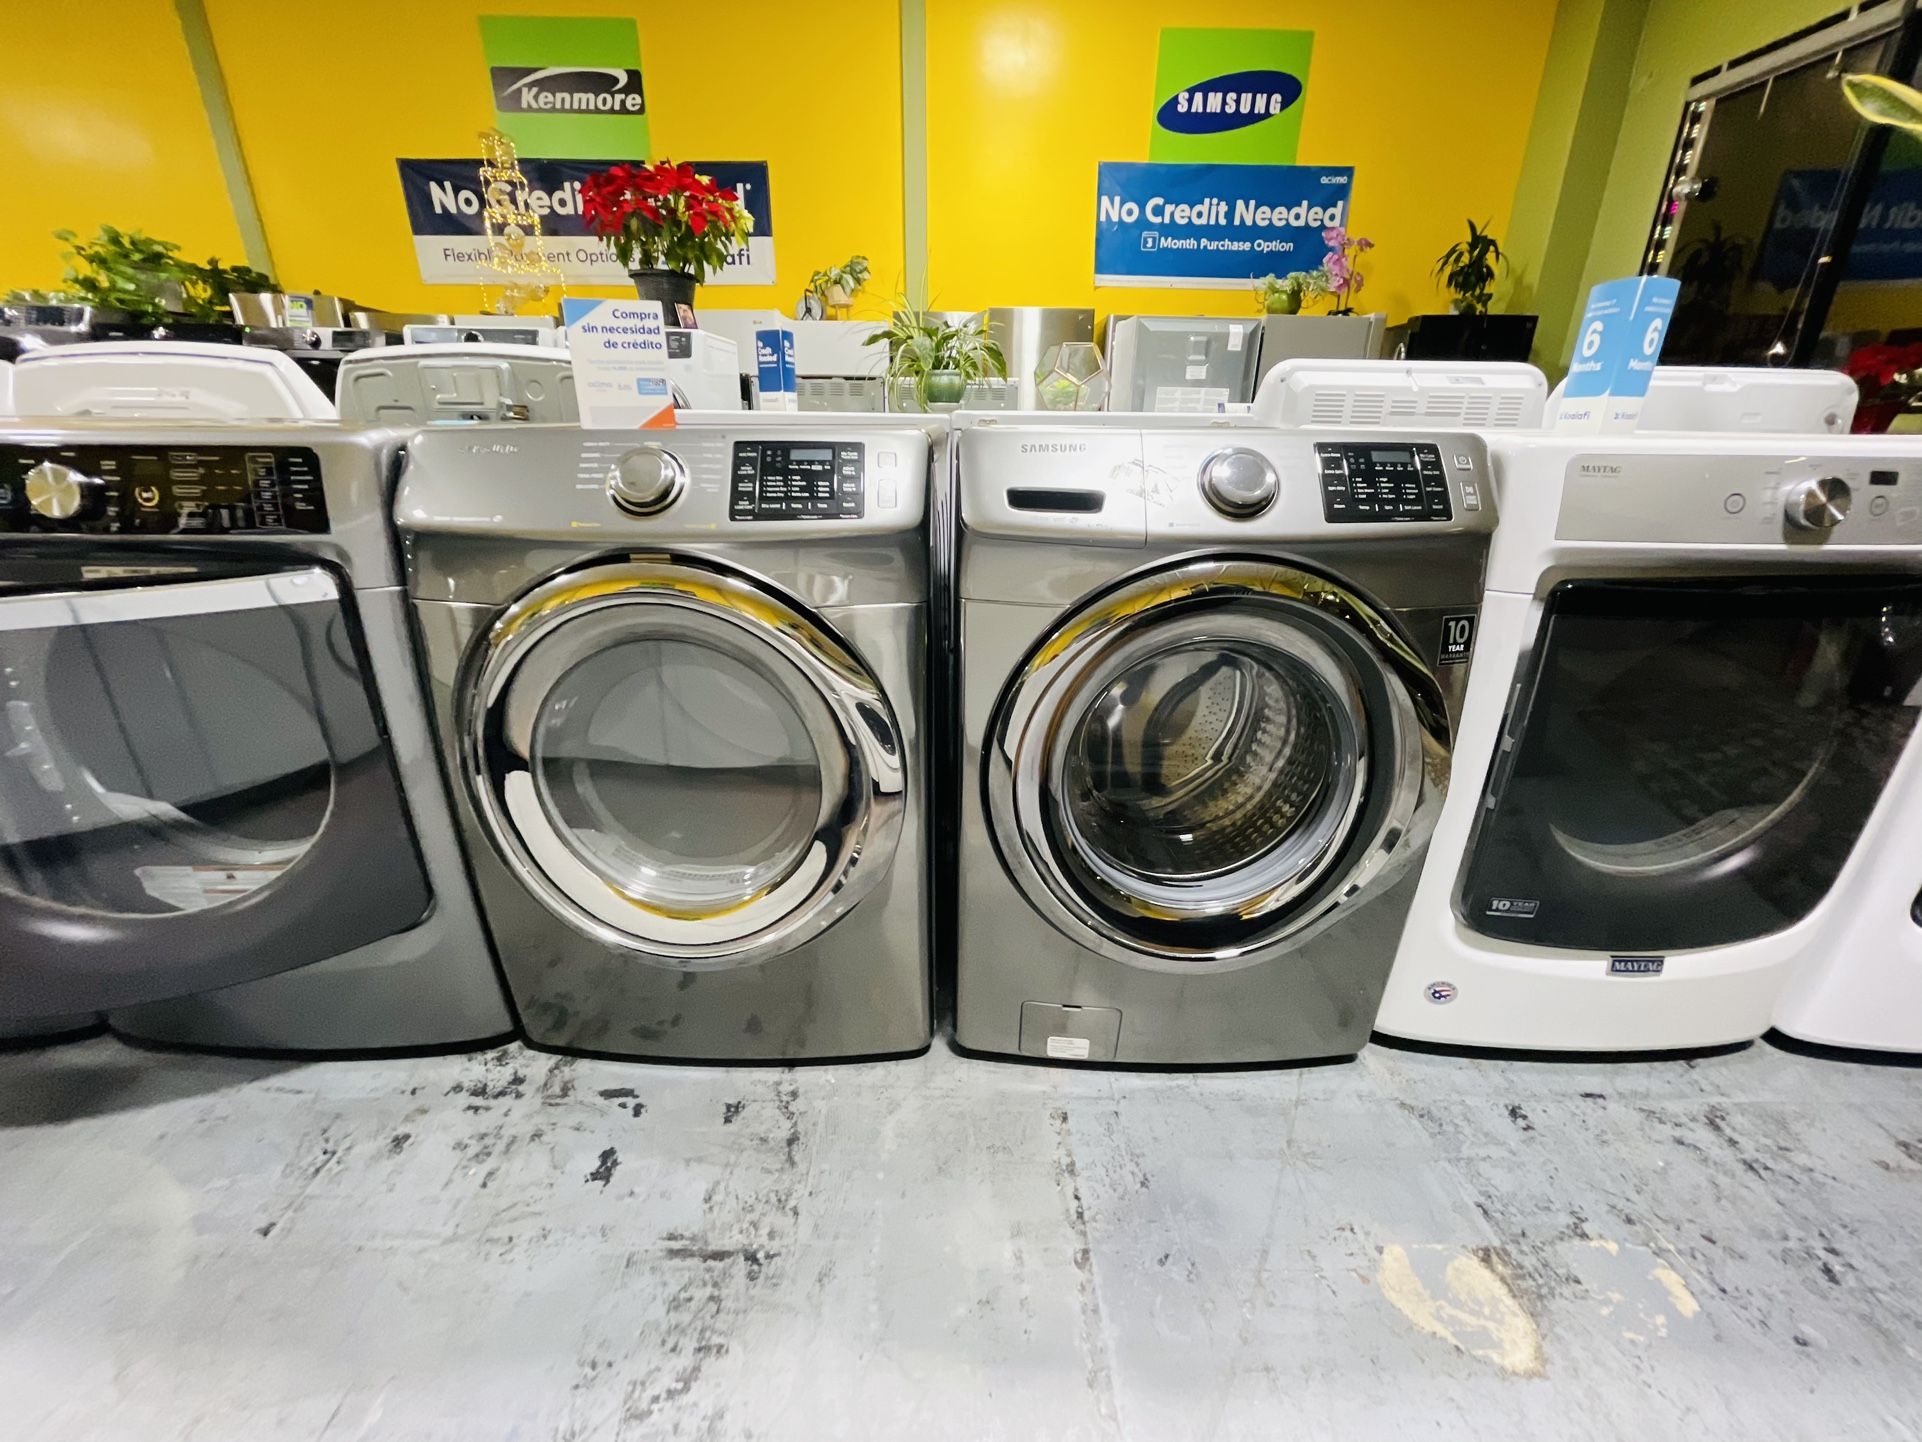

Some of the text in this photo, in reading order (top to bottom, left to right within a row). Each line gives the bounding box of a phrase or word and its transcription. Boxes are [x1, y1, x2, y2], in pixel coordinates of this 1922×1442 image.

[521, 87, 642, 111] Kenmore
[1177, 91, 1282, 114] SAMSUNG
[1320, 175, 1347, 184] acima
[429, 181, 583, 215] No Credi
[1100, 195, 1344, 228] No Credit Needed
[1146, 237, 1293, 253] 3 Month Purchase Option
[442, 247, 493, 262] Flexibl
[575, 249, 636, 265] Optios
[612, 308, 659, 321] Compra
[582, 323, 660, 335] sin necesidad
[1582, 320, 1604, 357] 6
[1643, 318, 1662, 355] 6
[603, 339, 618, 349] de
[621, 340, 662, 350] crédito
[1021, 443, 1087, 453] SAMSUNG
[1580, 465, 1622, 473] MAYTAG
[1448, 619, 1470, 644] 10
[1448, 644, 1464, 652] YEAR
[1491, 900, 1511, 911] 10
[1613, 961, 1664, 972] MAYTAG
